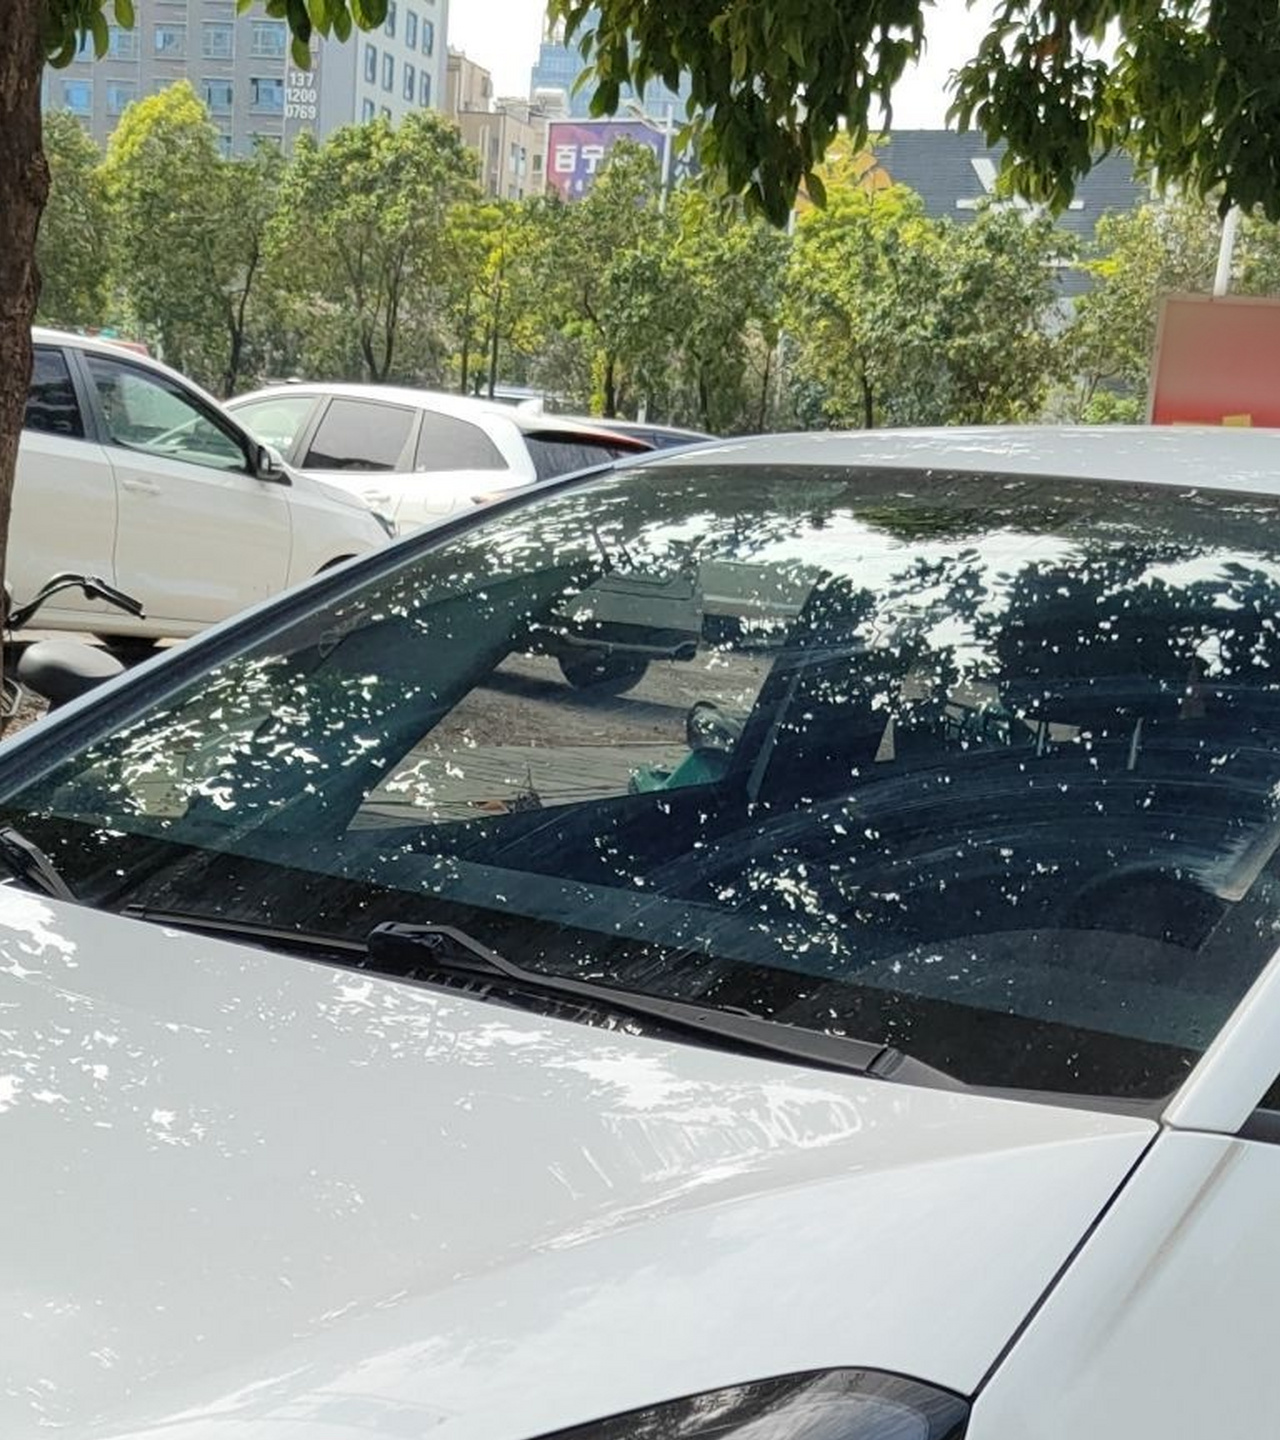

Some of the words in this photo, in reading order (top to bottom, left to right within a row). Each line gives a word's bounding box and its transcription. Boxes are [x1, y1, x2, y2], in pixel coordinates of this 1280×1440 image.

[289, 73, 314, 87] 137
[285, 88, 317, 103] 1200
[285, 104, 317, 119] 0769
